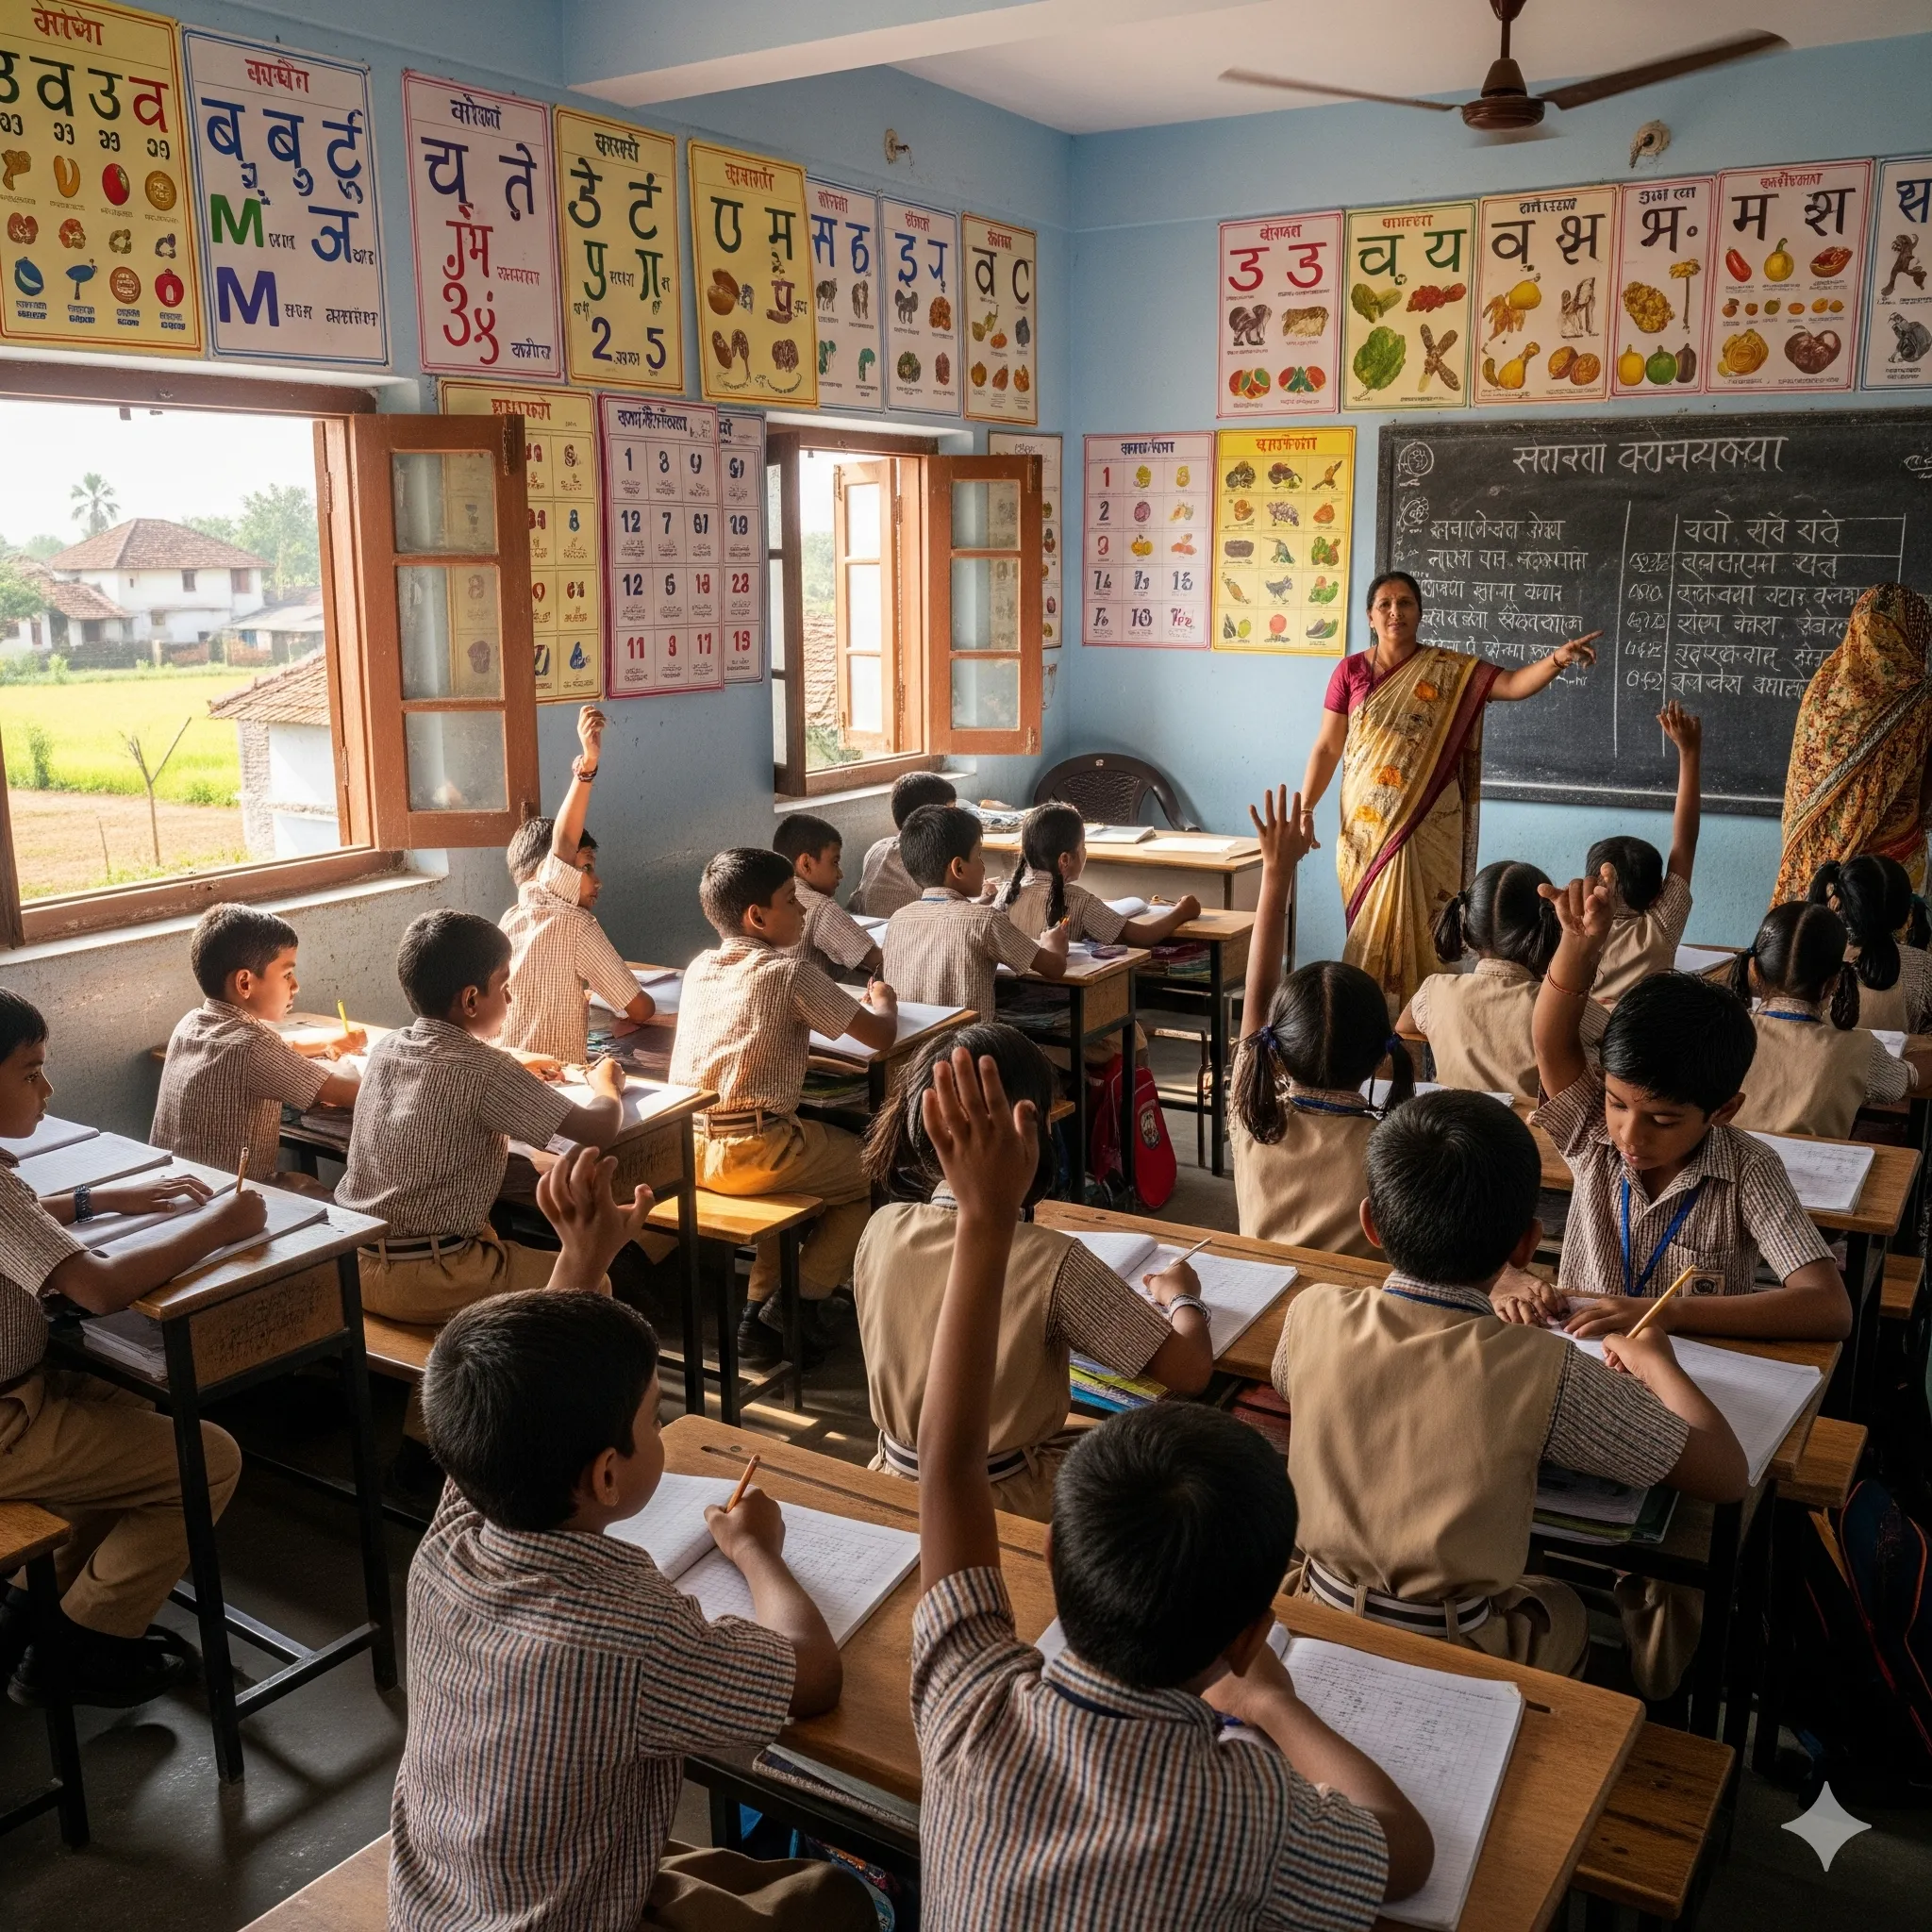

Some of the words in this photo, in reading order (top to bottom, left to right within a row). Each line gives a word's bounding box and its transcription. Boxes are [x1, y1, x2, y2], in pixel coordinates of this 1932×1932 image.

[29, 56, 75, 117] व
[88, 68, 123, 121] उ
[128, 75, 169, 133] व
[210, 193, 264, 248] M
[1732, 193, 1779, 241] म
[1228, 247, 1270, 291] उ
[1424, 228, 1467, 272] य
[216, 266, 279, 326] M
[591, 316, 612, 361] 2
[646, 326, 666, 369] 5
[624, 447, 632, 472] 1
[1103, 466, 1110, 487] 1
[621, 509, 641, 533] 12
[662, 511, 672, 534] 7
[1099, 500, 1109, 521] 2
[622, 573, 643, 596] 12
[626, 637, 645, 658] 11
